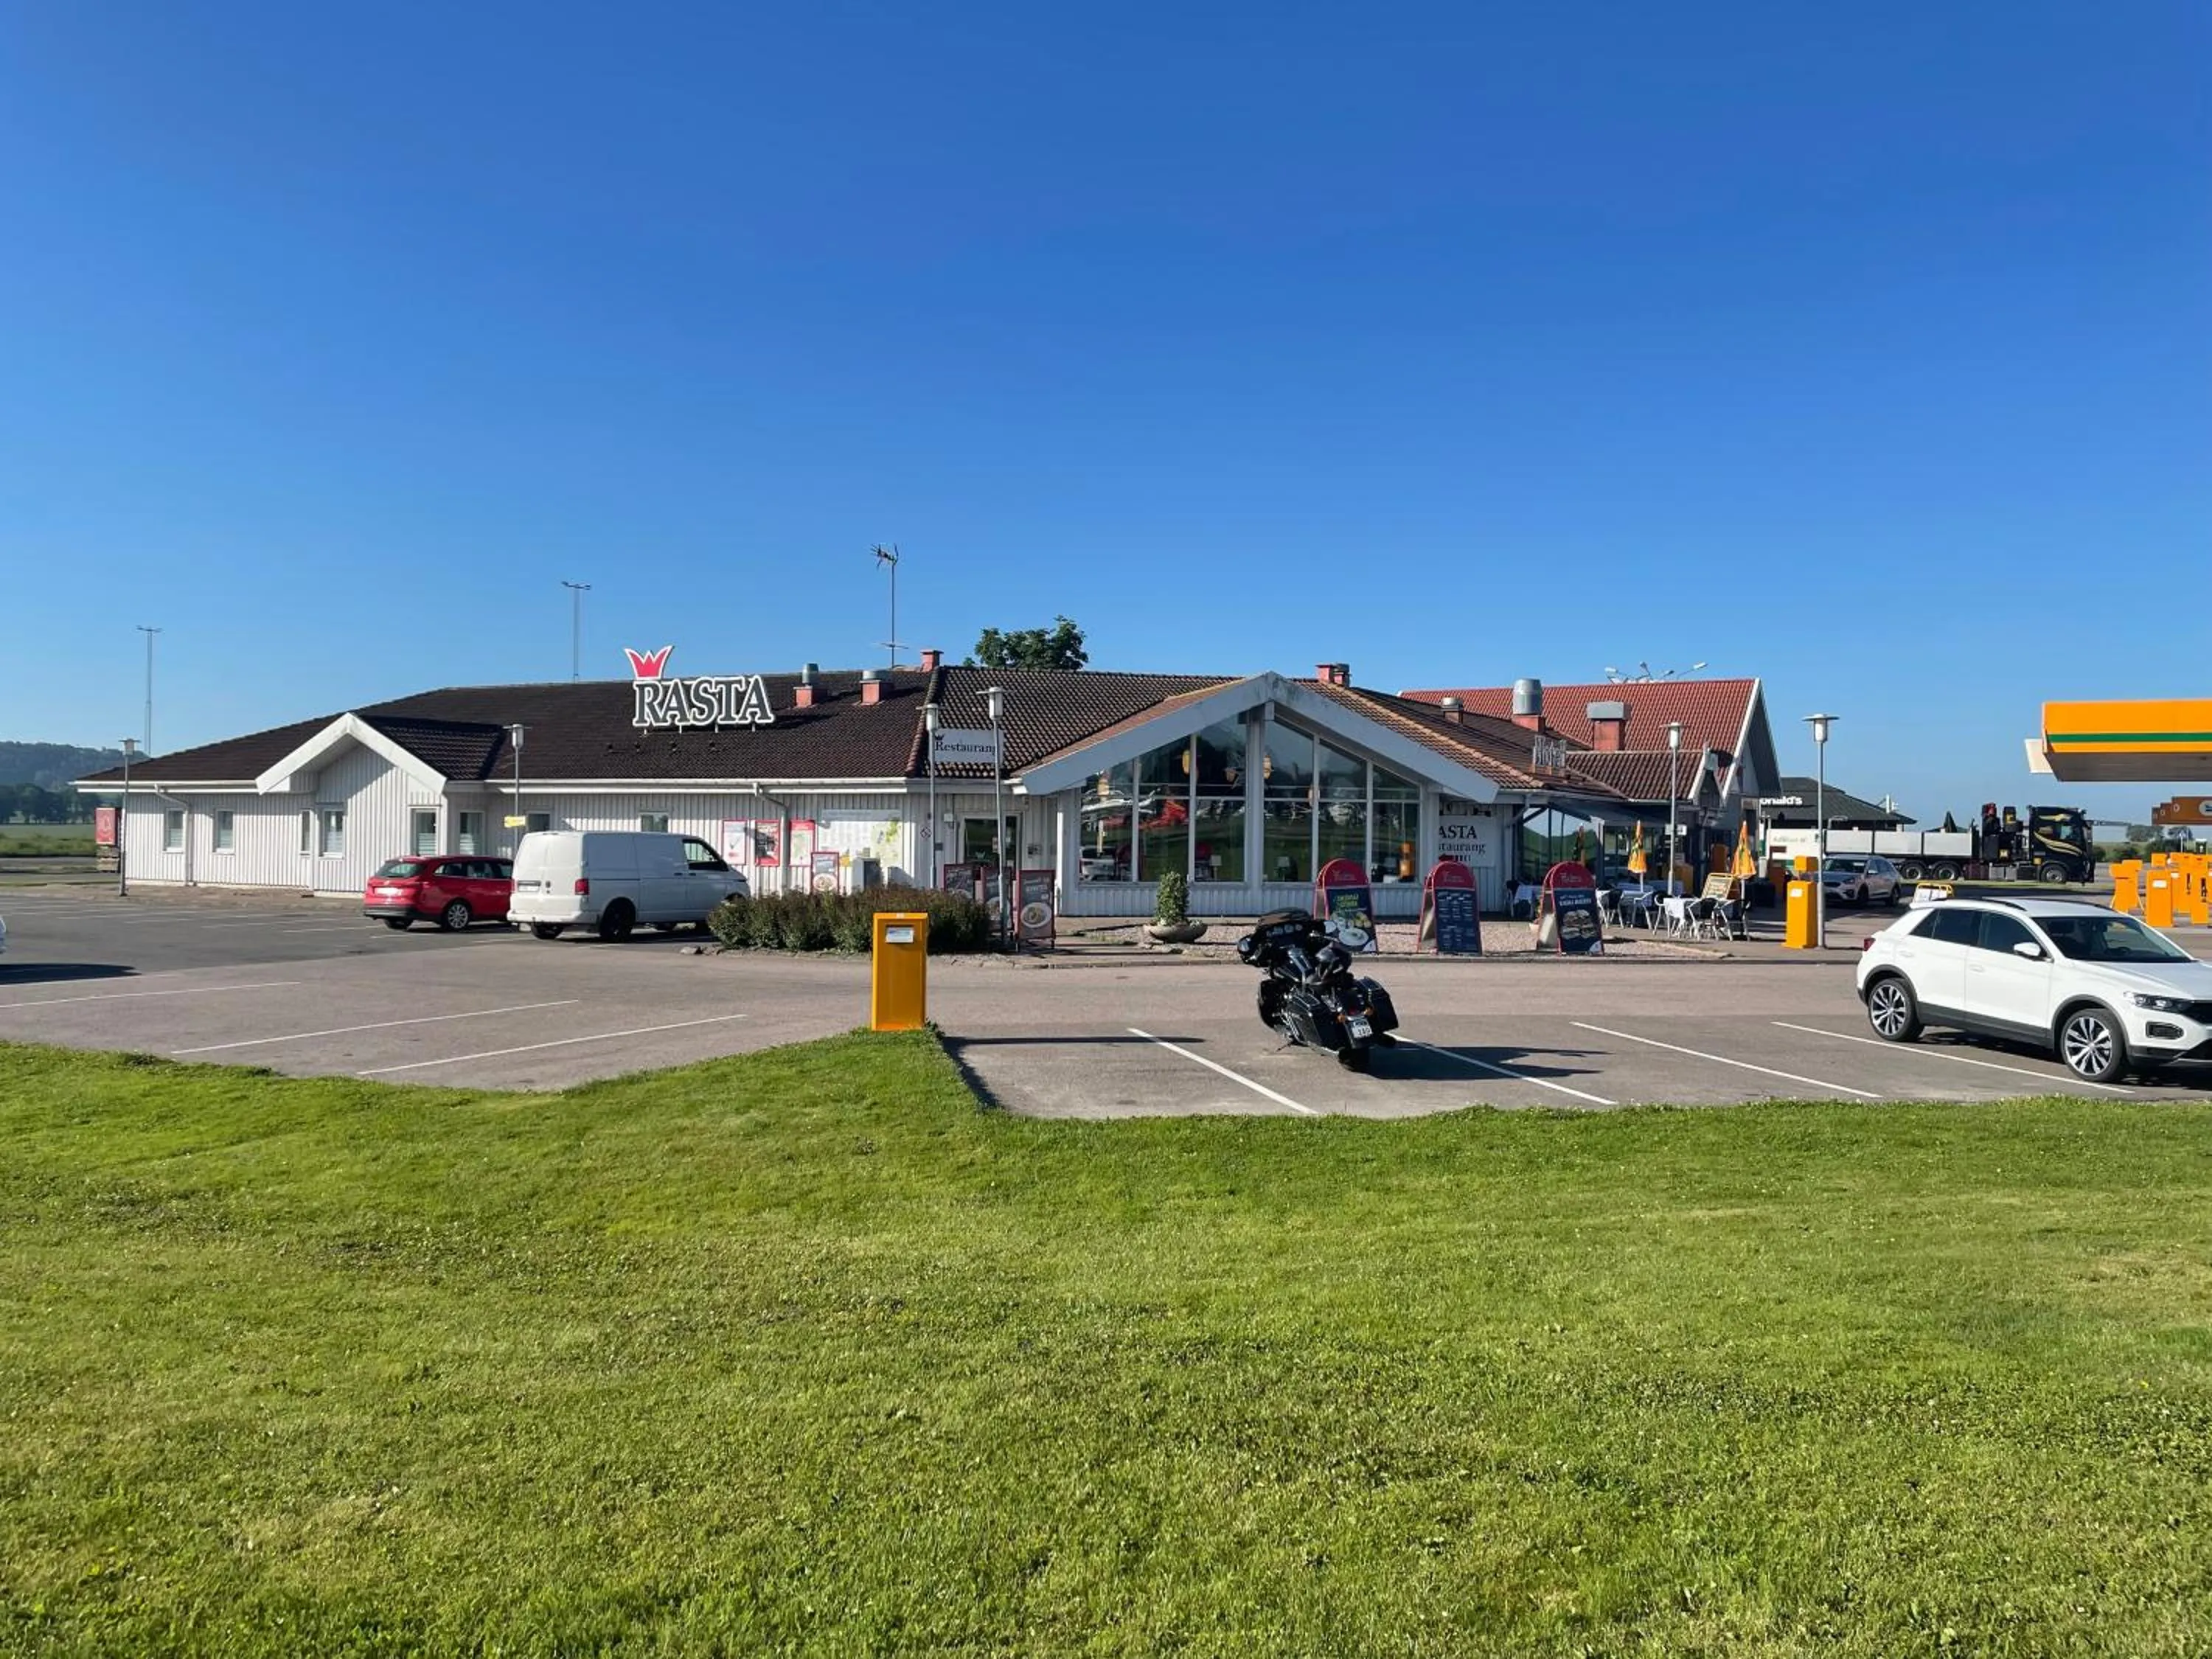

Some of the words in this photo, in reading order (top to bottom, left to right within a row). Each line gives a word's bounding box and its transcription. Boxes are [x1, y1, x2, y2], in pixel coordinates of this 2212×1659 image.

[633, 675, 774, 726] RASTA
[1759, 796, 1803, 805] onald's
[1439, 825, 1478, 839] ASTA
[1439, 843, 1486, 855] taurang
